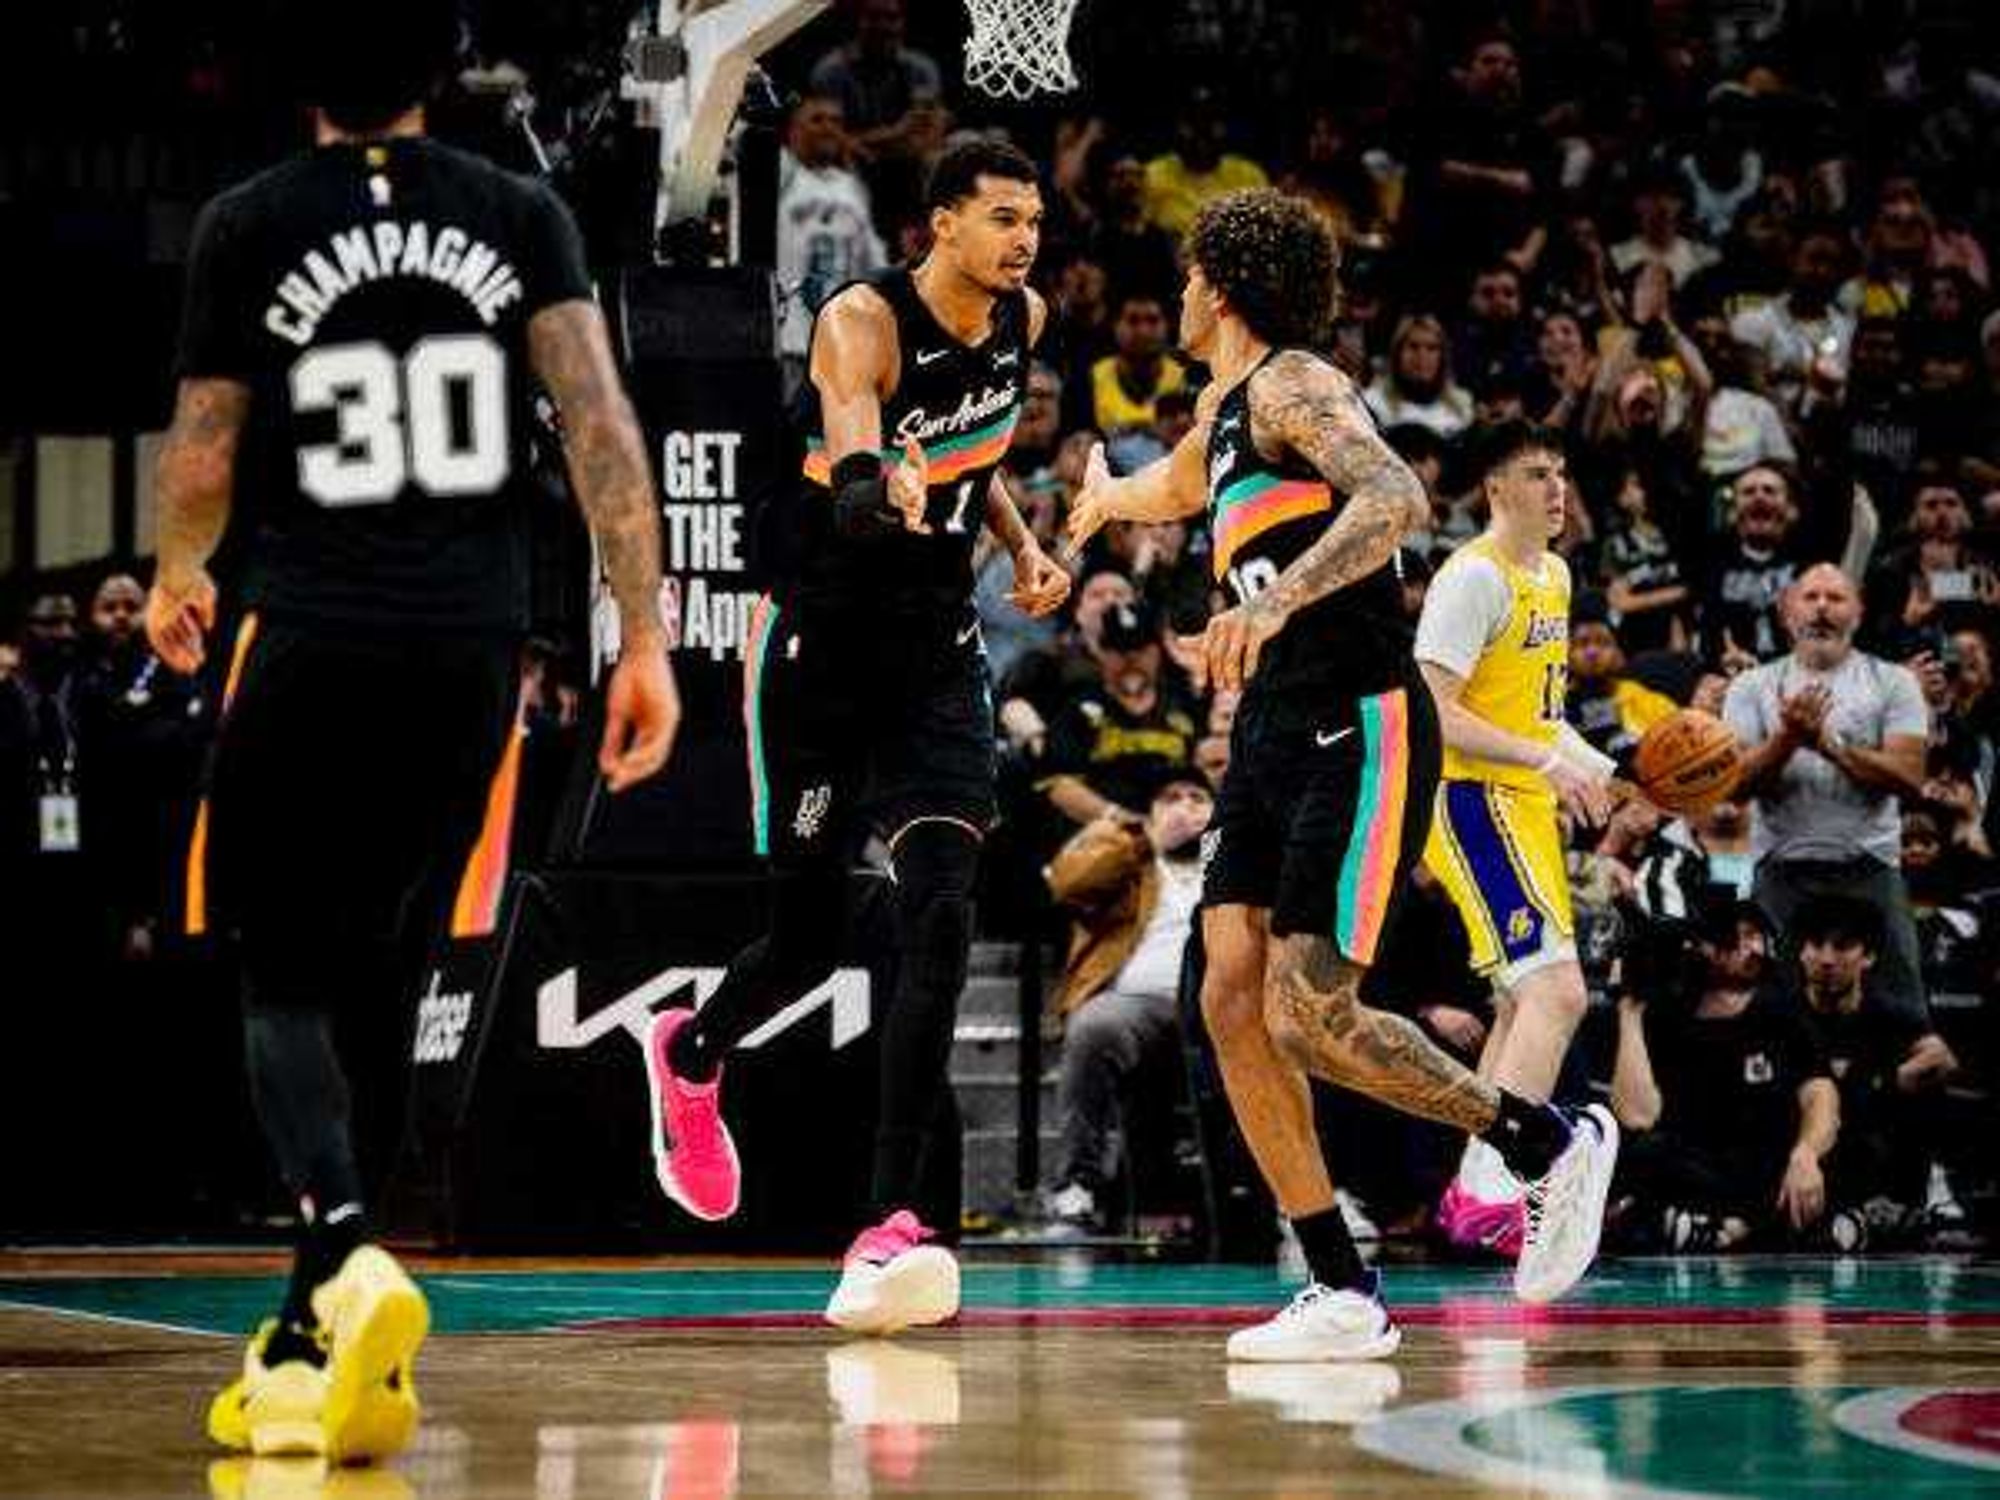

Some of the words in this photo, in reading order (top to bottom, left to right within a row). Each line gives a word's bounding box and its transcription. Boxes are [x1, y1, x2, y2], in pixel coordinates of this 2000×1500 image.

[265, 220, 521, 345] CHAMPAGNIE
[288, 334, 509, 507] 30
[663, 430, 742, 499] GET
[663, 503, 744, 571] THE
[946, 480, 975, 533] 1
